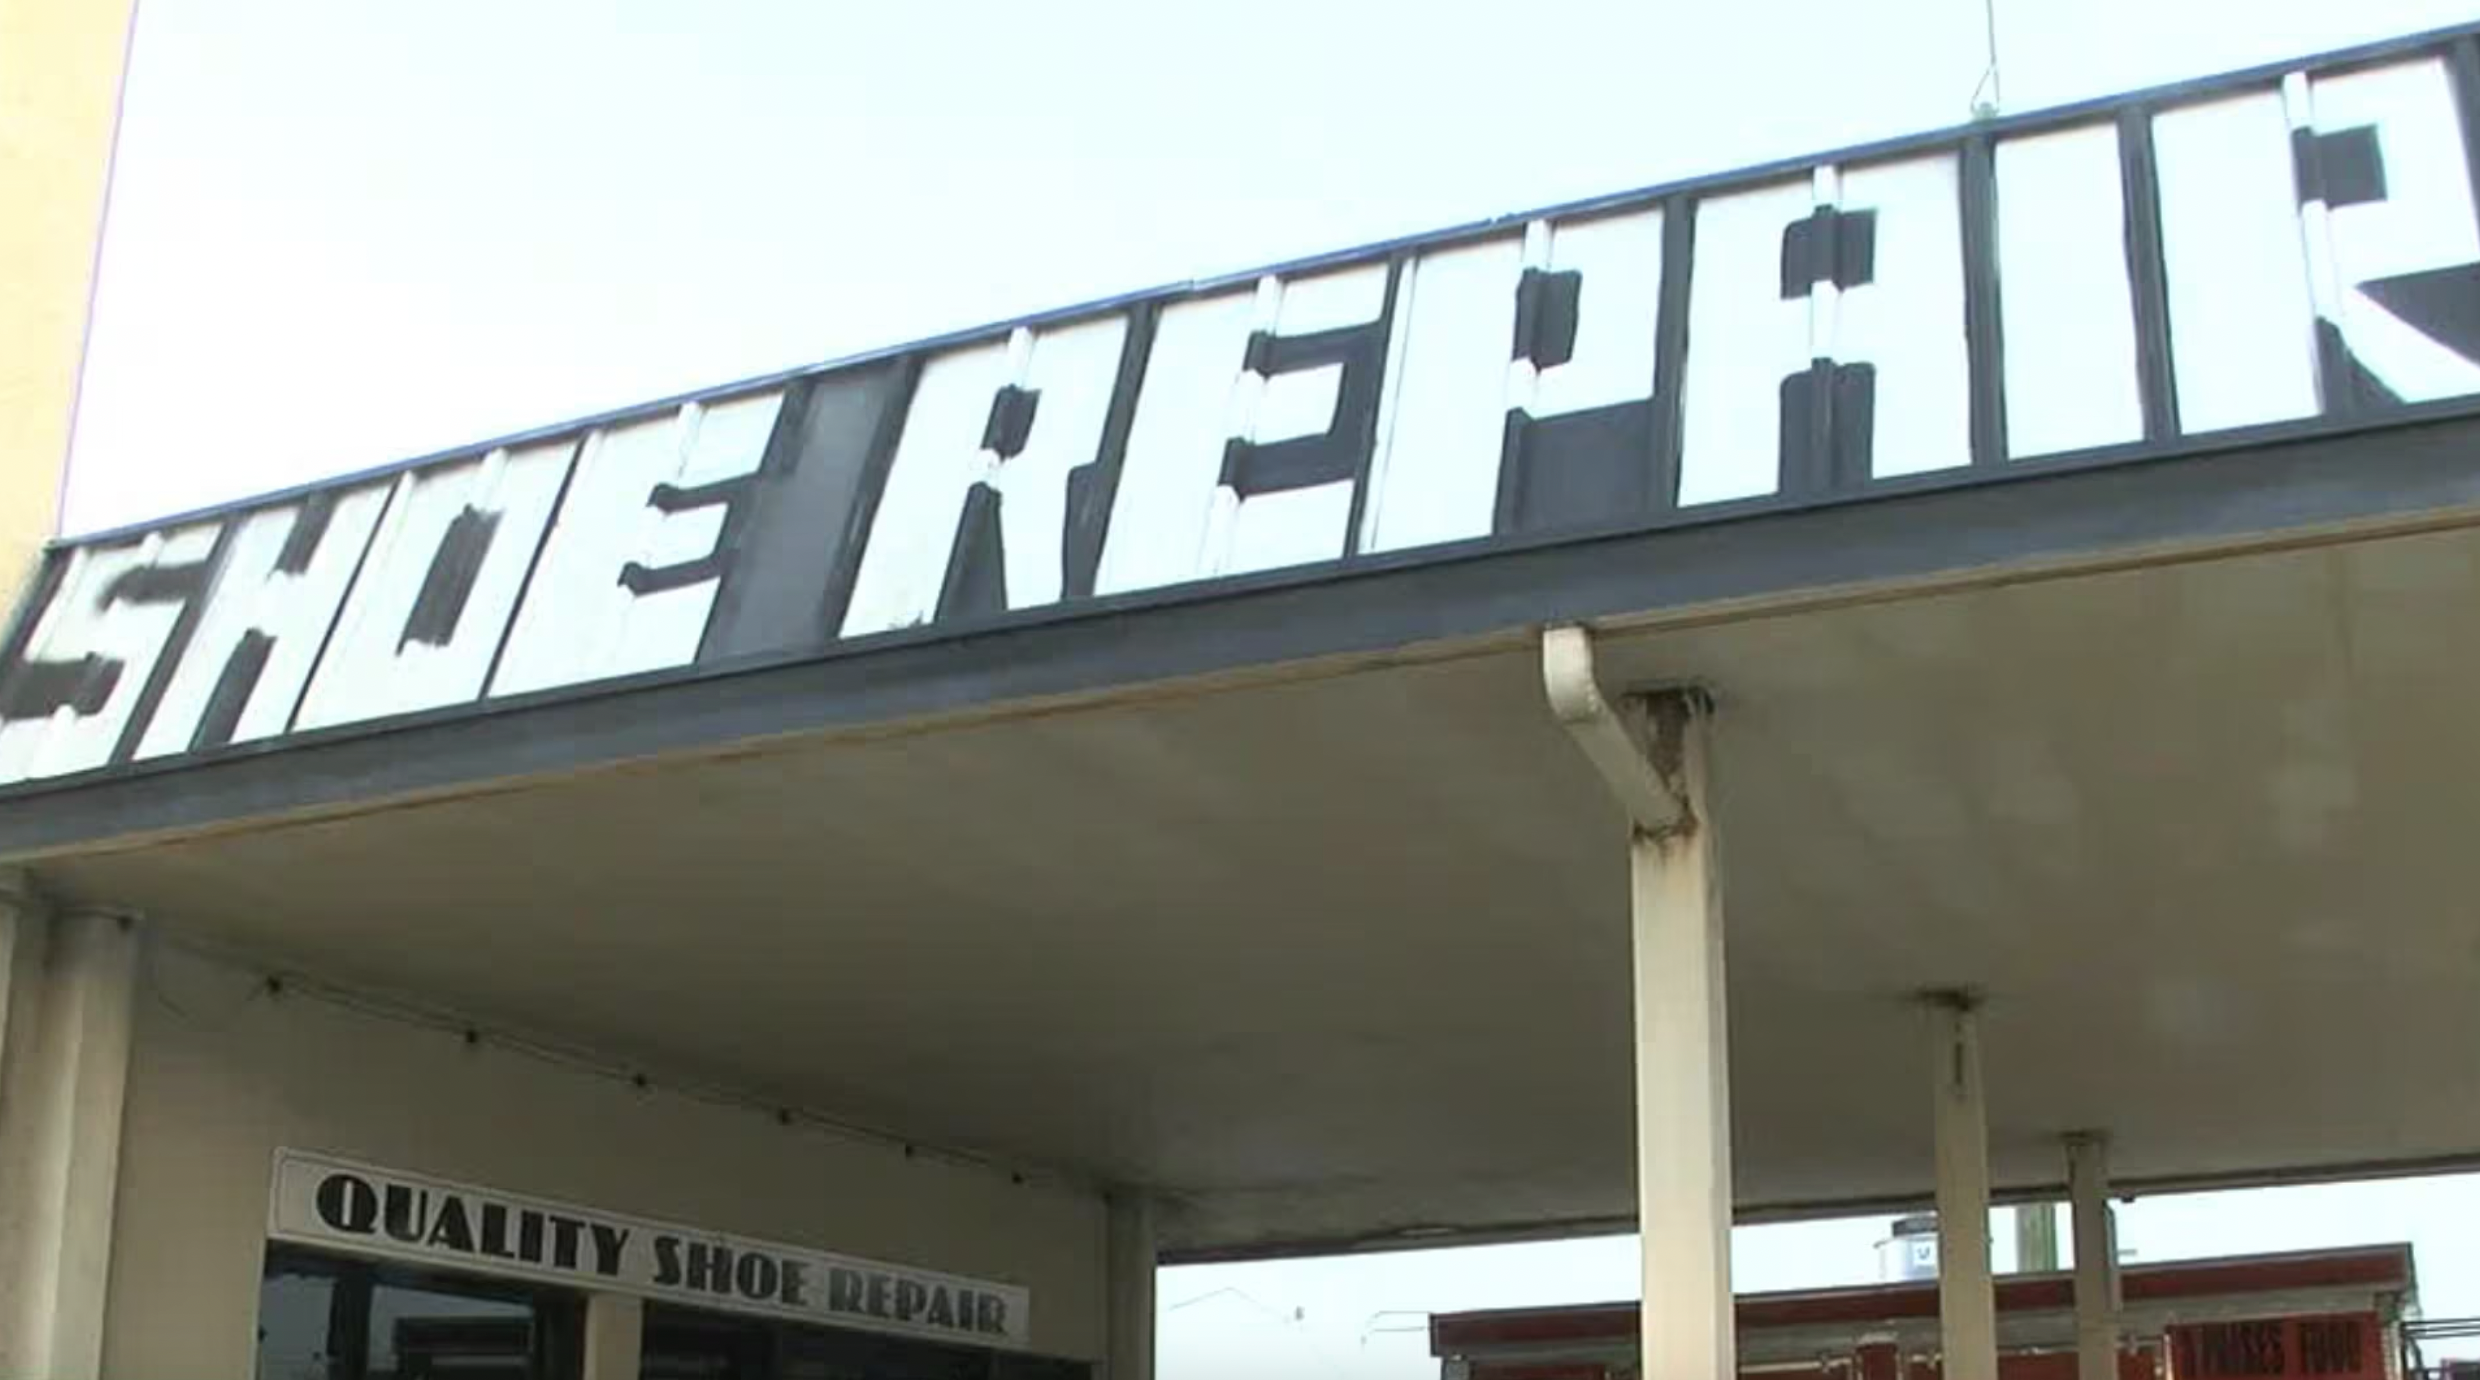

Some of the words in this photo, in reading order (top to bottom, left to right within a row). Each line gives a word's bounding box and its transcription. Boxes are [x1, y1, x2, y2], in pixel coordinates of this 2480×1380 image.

[0, 393, 785, 785] SHOE
[838, 57, 2480, 638] REPAIR
[316, 1174, 629, 1276] QUALITY
[652, 1235, 809, 1304] SHOE
[828, 1267, 1006, 1336] REPAIR
